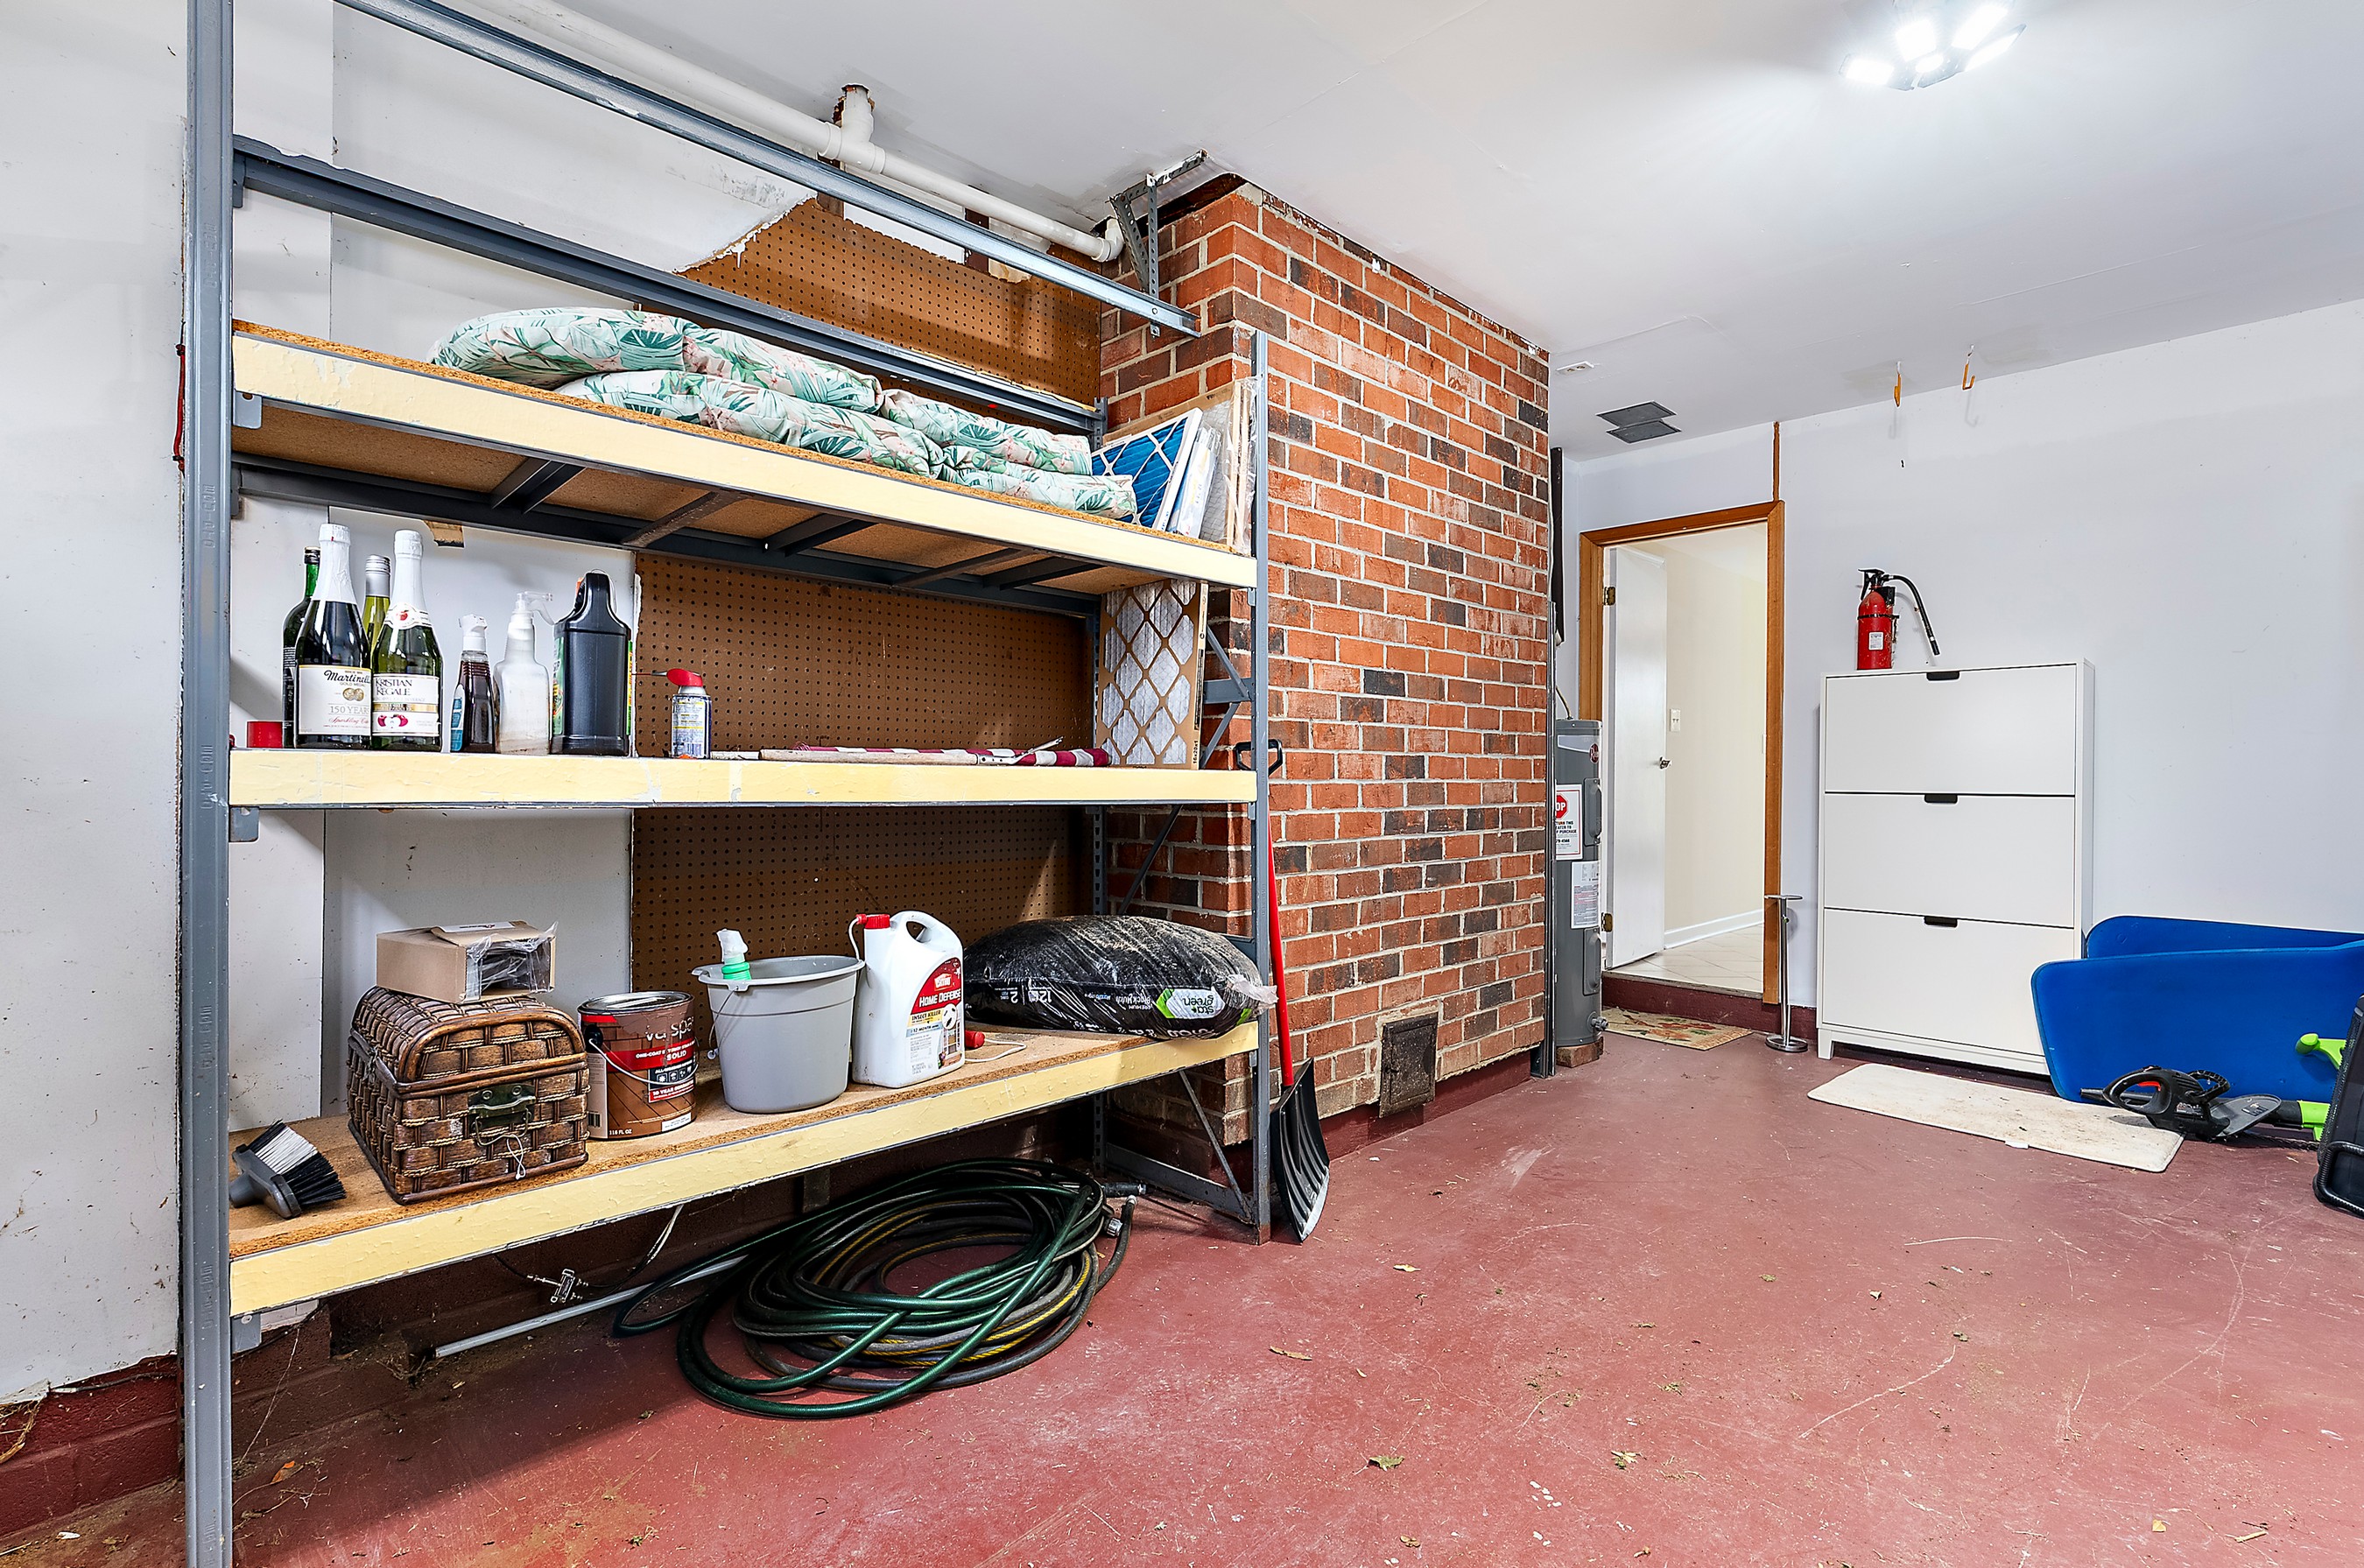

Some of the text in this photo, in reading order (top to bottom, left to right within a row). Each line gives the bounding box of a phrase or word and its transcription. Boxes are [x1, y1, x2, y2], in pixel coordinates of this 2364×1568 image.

[375, 678, 412, 687] KRISTIAN
[376, 686, 412, 696] REGALE
[1556, 802, 1565, 811] OP
[919, 988, 961, 1008] HOME DEFENSE
[1010, 990, 1018, 1003] 2
[1182, 995, 1214, 1007] green
[911, 1012, 927, 1021] INSECT
[666, 1050, 687, 1061] SOLID
